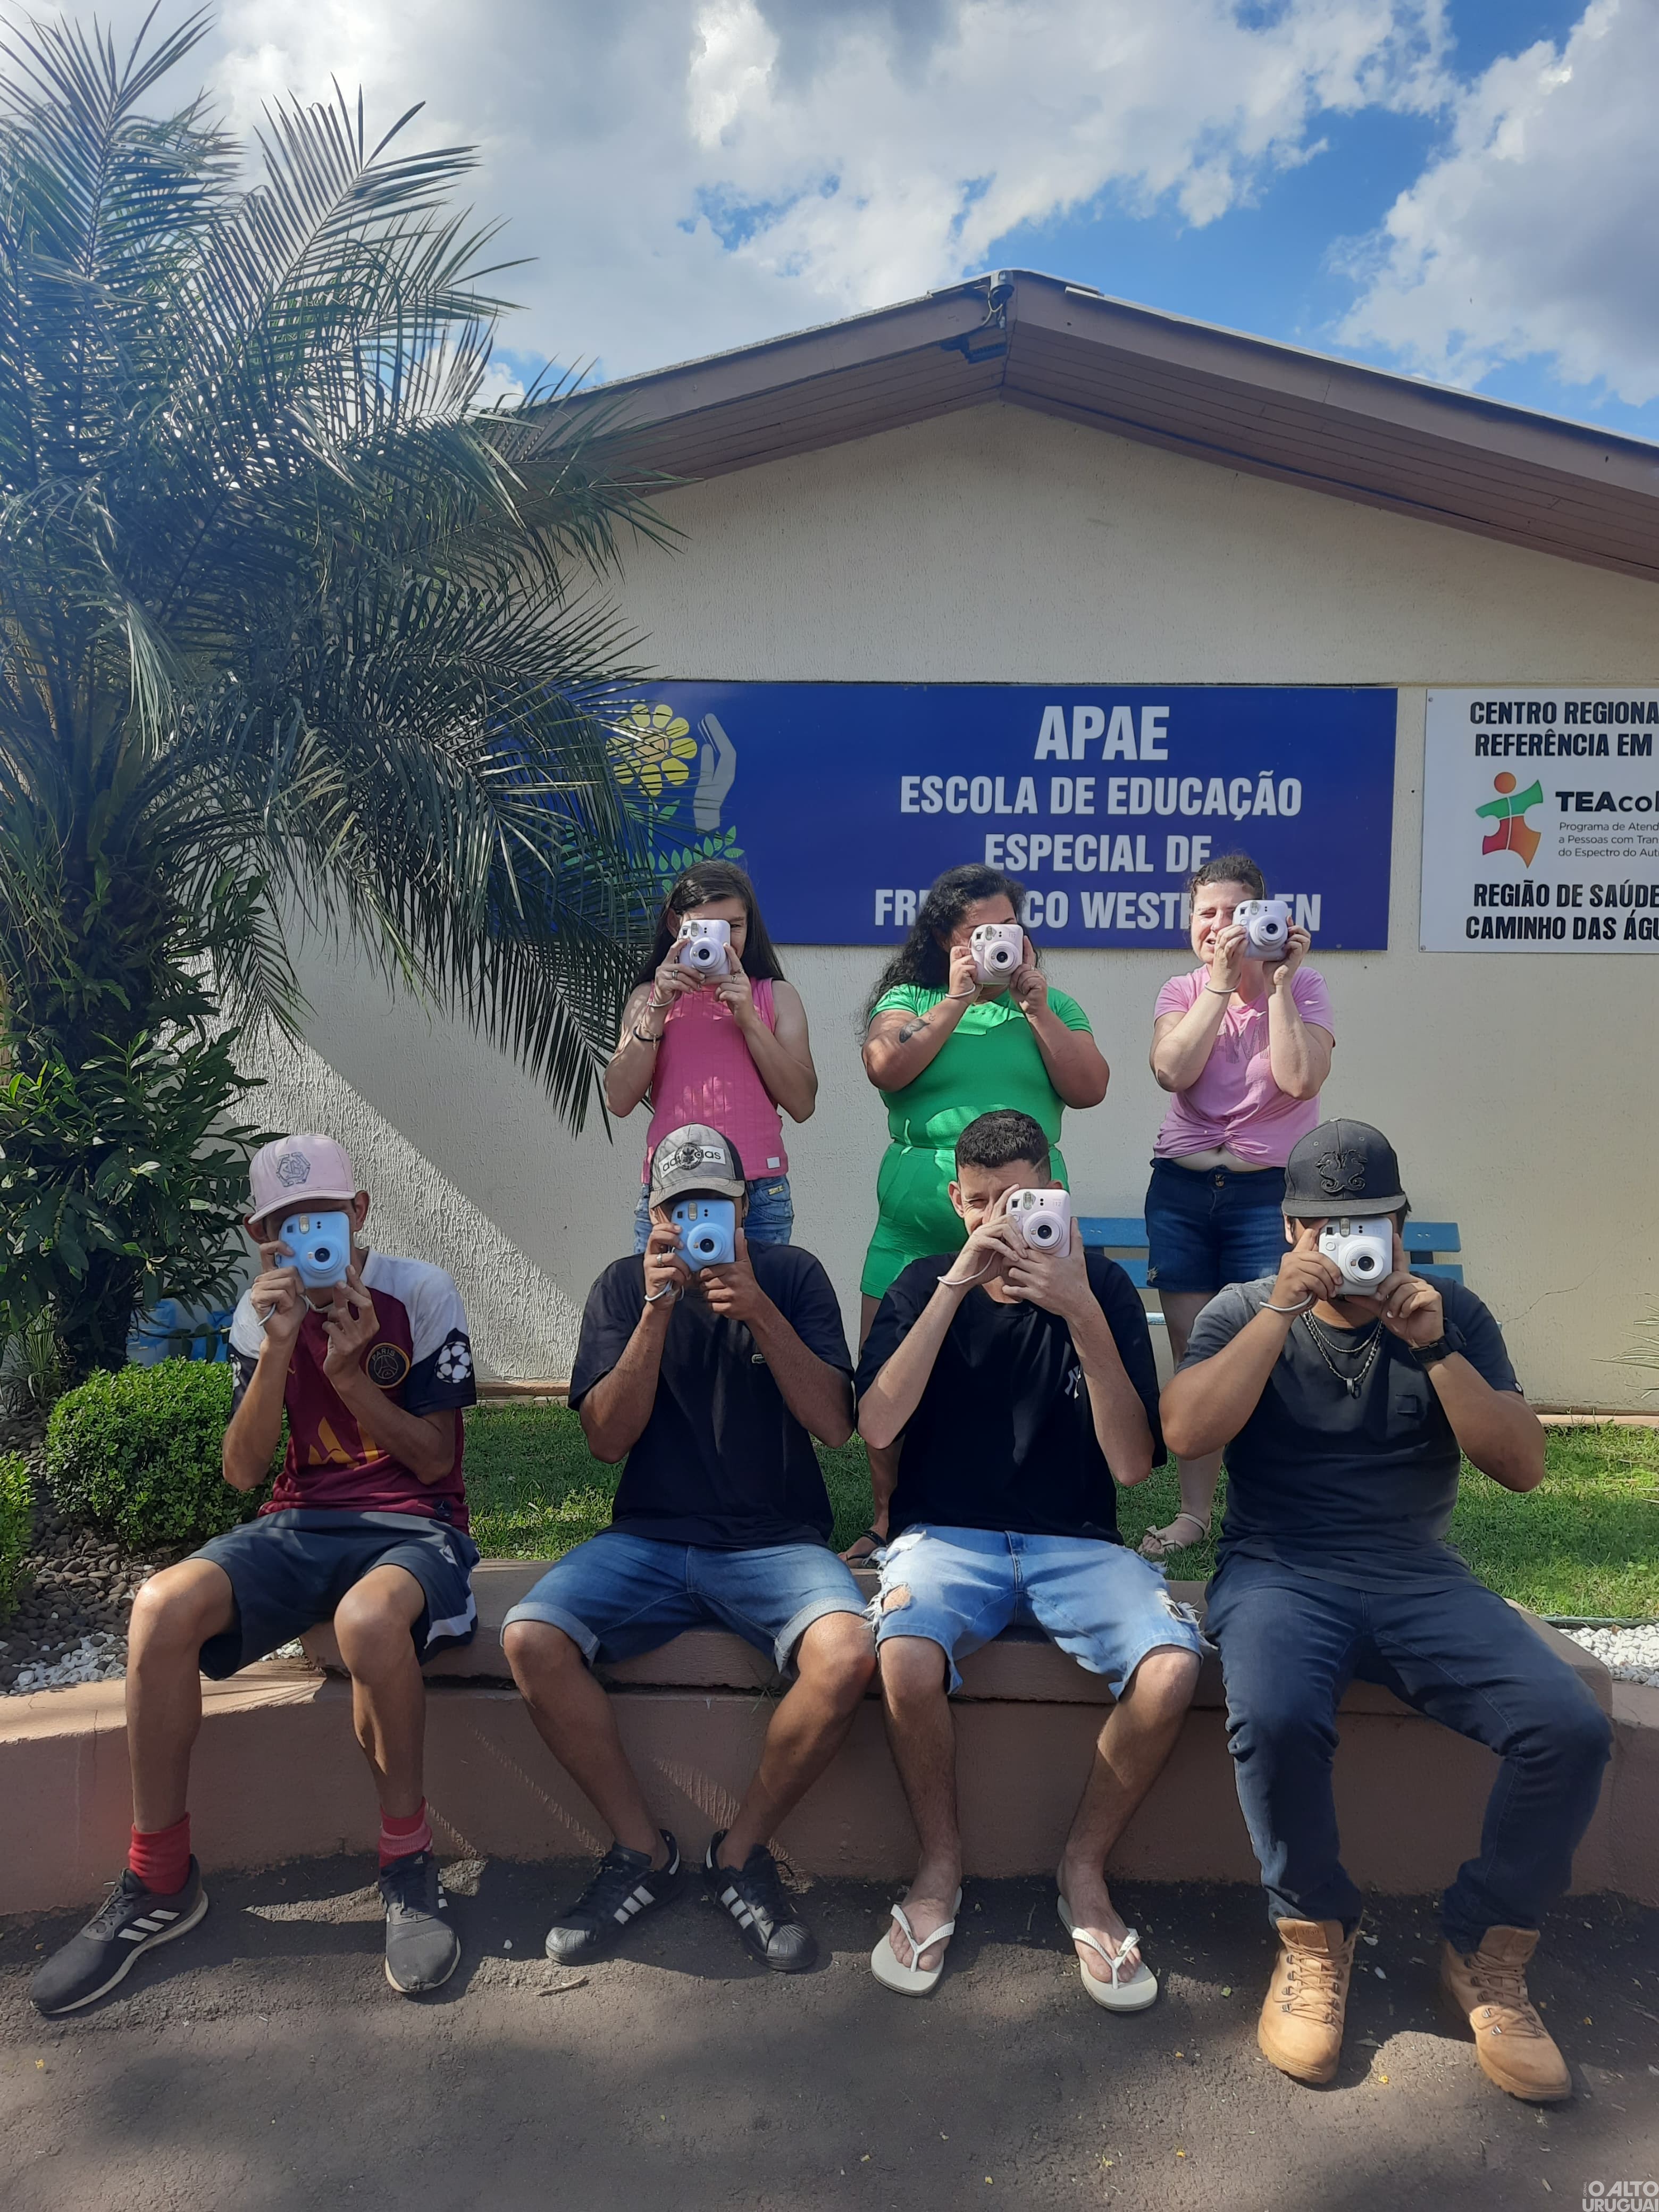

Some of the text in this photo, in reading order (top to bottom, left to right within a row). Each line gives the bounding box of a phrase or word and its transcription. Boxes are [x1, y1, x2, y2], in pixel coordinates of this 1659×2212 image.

[1470, 701, 1557, 724] CENTRO
[1034, 706, 1169, 760] APAE
[1474, 728, 1652, 756] REFERÊNCIA EM
[901, 770, 1302, 821] ESCOLA DE EDUCAÇÃO
[1560, 822, 1609, 832] Programa
[1612, 822, 1626, 831] de
[1568, 835, 1608, 844] Pessoas
[1637, 835, 1659, 844] Tran
[985, 834, 1212, 872] ESPECIAL DE
[1558, 848, 1572, 857] do
[1575, 848, 1620, 858] Espectro
[1623, 848, 1637, 857] do
[1474, 879, 1659, 908] REGIÃO DE SAÚDE
[1466, 916, 1566, 940] CAMINHO
[1573, 917, 1616, 940] DAS
[372, 1348, 395, 1361] PARIS
